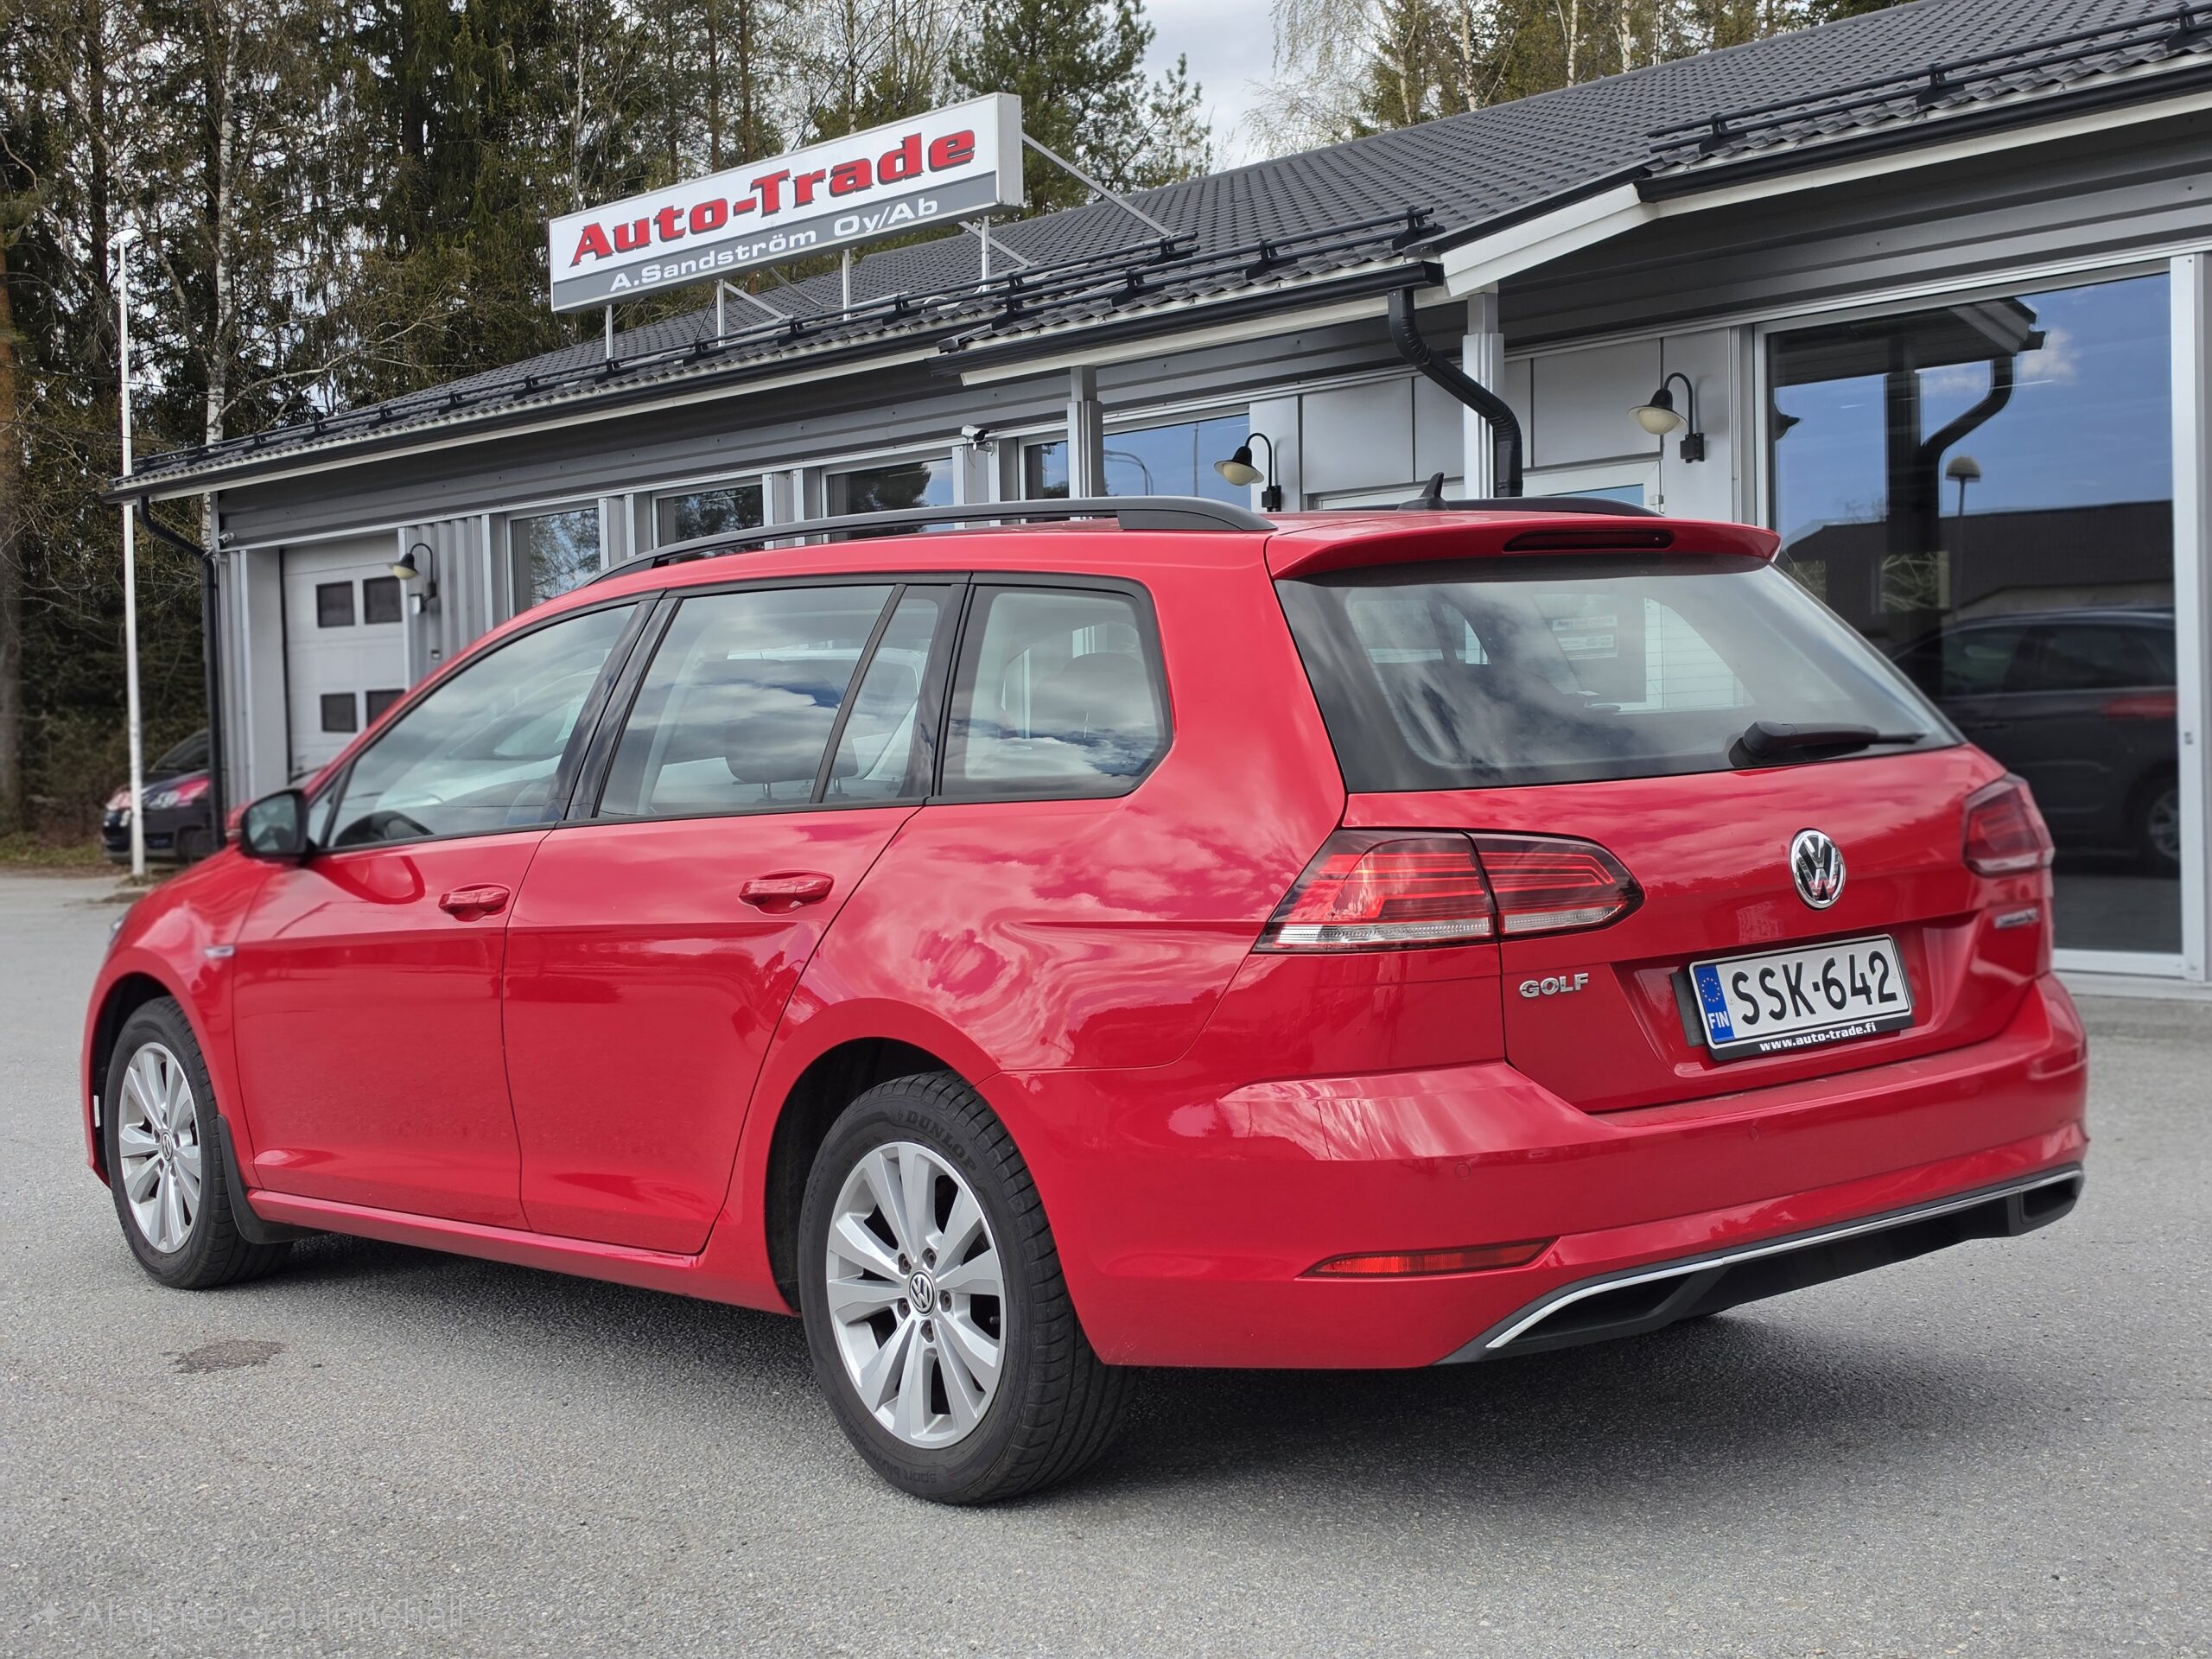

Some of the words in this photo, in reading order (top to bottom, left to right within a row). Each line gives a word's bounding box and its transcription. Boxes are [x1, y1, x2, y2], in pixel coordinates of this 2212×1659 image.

[569, 130, 976, 267] Auto-Trade
[610, 227, 817, 292] A.Sandström
[834, 198, 938, 236] Oy/Ab
[1519, 973, 1589, 998] GOLF
[1732, 950, 1897, 1025] SSK-642
[1707, 1011, 1731, 1030] FIN
[1759, 1022, 1877, 1052] www.auto-trade.fi
[906, 1110, 977, 1171] DUNLOP
